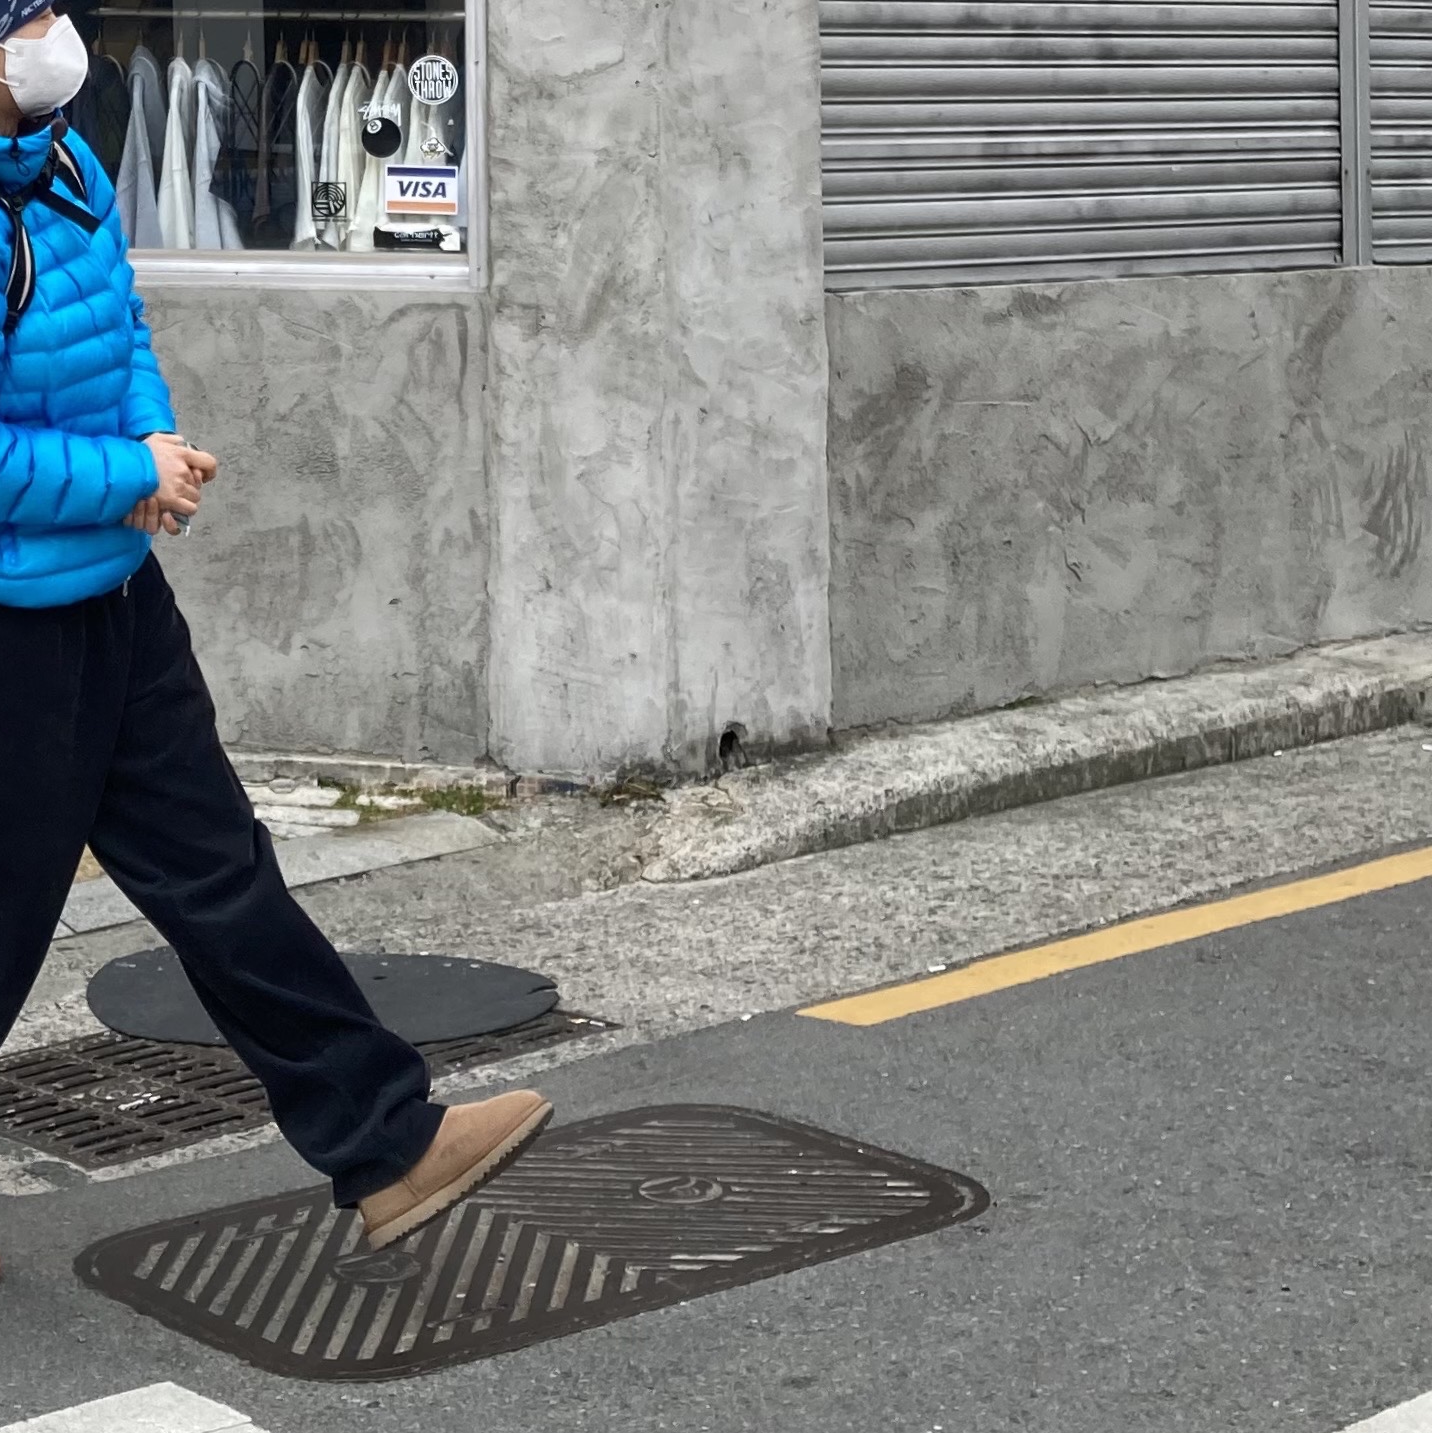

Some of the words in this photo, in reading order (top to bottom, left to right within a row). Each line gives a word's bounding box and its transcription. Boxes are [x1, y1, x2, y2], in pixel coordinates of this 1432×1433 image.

[413, 61, 453, 81] STONES
[414, 79, 452, 100] THROW
[397, 180, 447, 199] VISA
